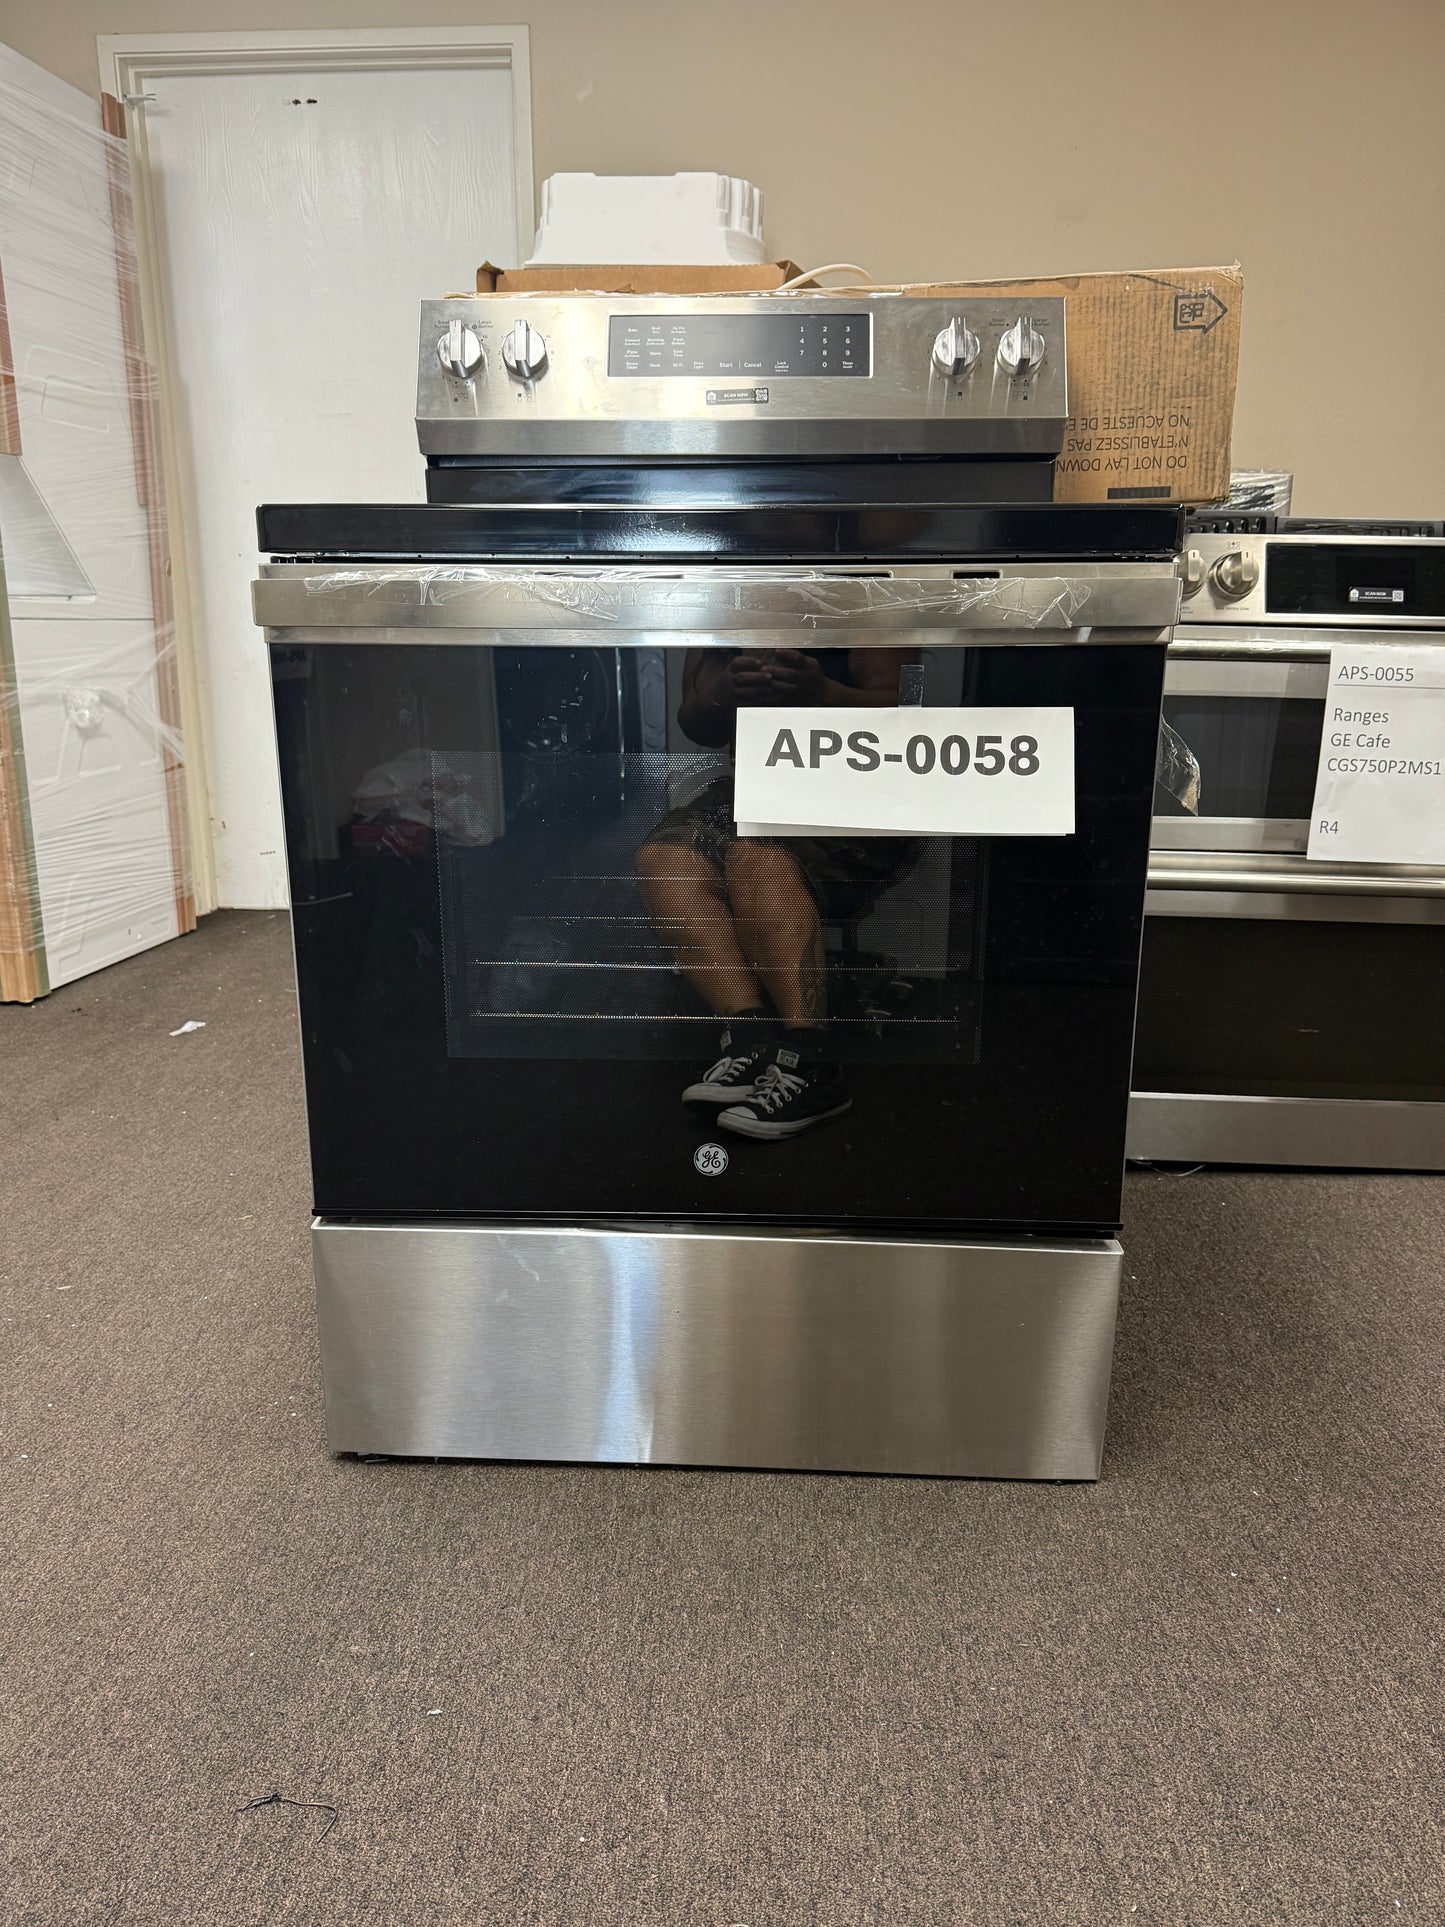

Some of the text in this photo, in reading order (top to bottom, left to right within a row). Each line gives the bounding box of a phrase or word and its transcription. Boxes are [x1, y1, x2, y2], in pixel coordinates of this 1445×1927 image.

[1080, 417, 1098, 431] DE
[1103, 415, 1164, 430] ACUESTE
[1168, 414, 1190, 428] NO
[1067, 438, 1092, 452] PAS
[1056, 455, 1187, 473] DO NOT LAY DOWN
[1338, 665, 1414, 682] APS-0055
[1333, 708, 1389, 726] Ranges
[1330, 733, 1391, 748] GE Cafe
[764, 728, 1040, 776] APS-0058
[1327, 758, 1442, 775] CGS750P2MS1
[1319, 820, 1339, 834] R4
